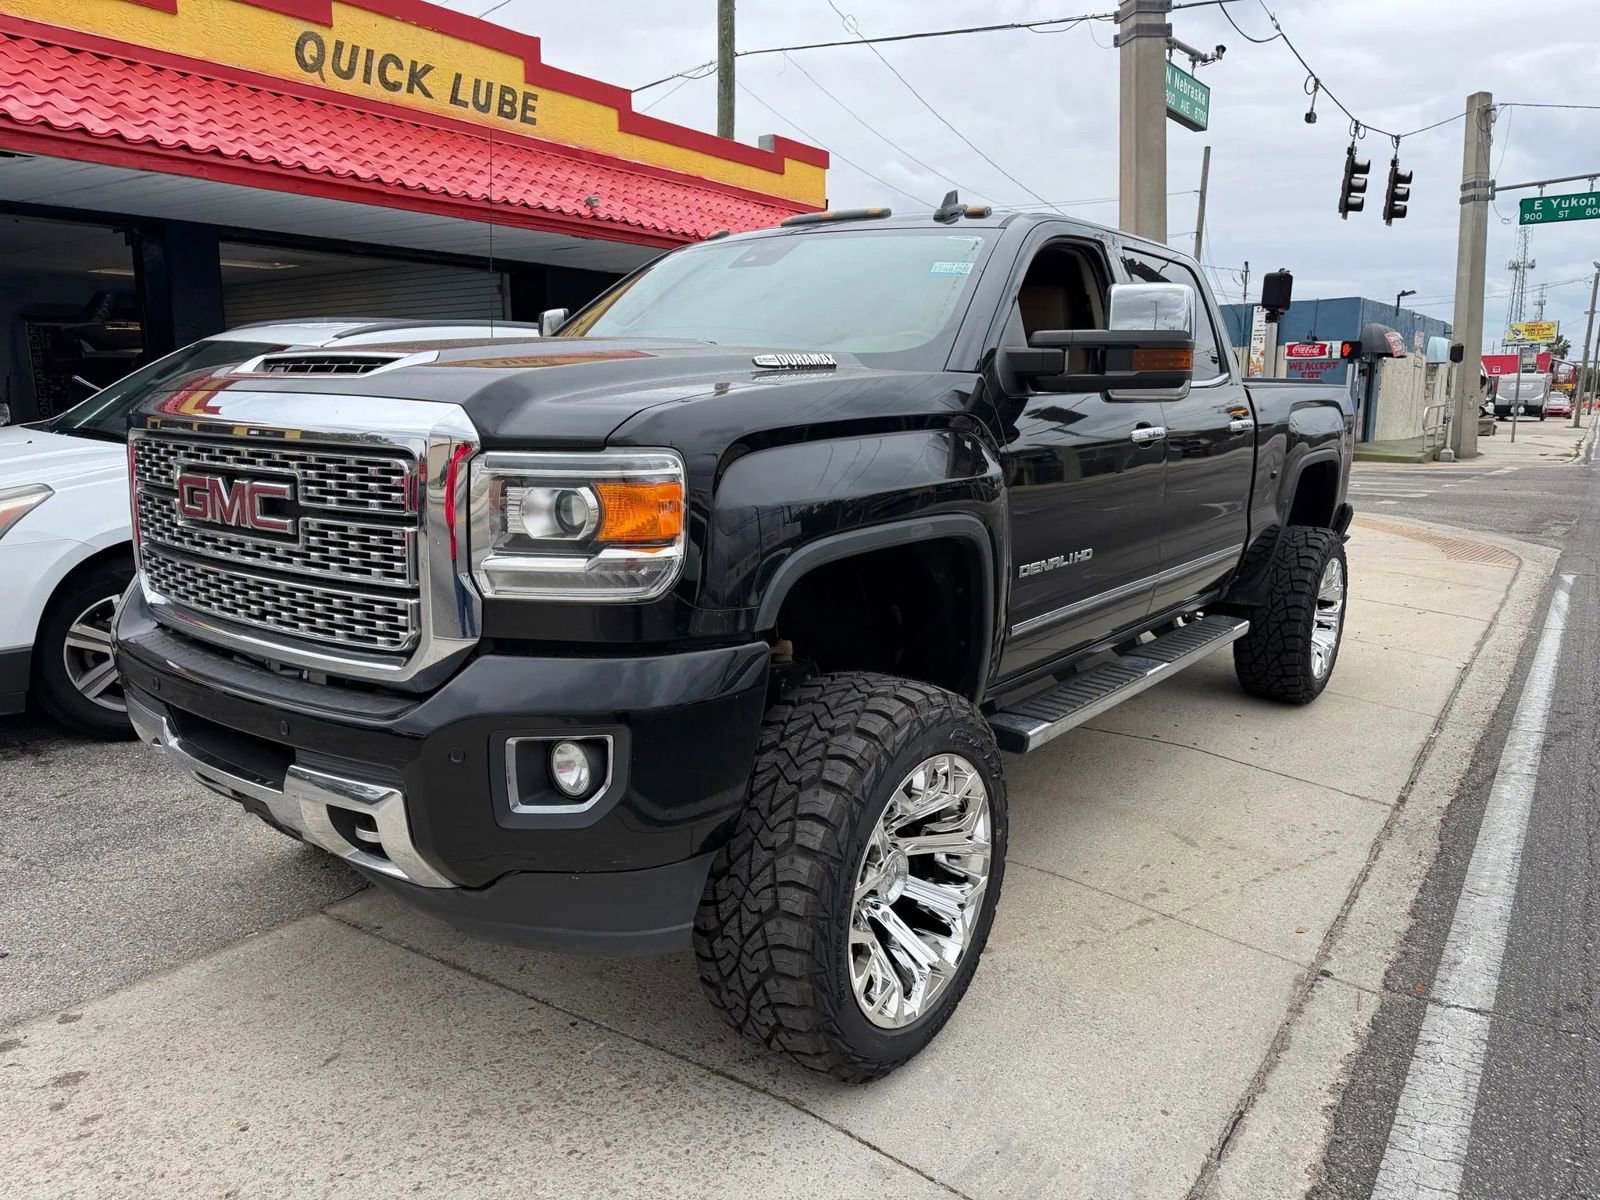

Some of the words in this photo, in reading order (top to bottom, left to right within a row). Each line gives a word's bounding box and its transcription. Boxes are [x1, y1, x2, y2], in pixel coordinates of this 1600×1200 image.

[294, 30, 436, 99] QUICK
[449, 72, 539, 126] LUBE
[1166, 66, 1171, 85] N
[1174, 72, 1206, 106] Nebraska
[1180, 99, 1191, 114] AVE
[1534, 200, 1543, 210] E
[1551, 197, 1596, 209] Yukon
[1524, 212, 1543, 221] 900
[1558, 210, 1570, 218] ST
[775, 353, 837, 369] DURAMAX
[1288, 361, 1304, 371] WE
[1304, 361, 1339, 371] ACCEPT
[178, 473, 296, 535] GMC
[1018, 552, 1073, 579] DENALI
[1074, 548, 1093, 564] HD
